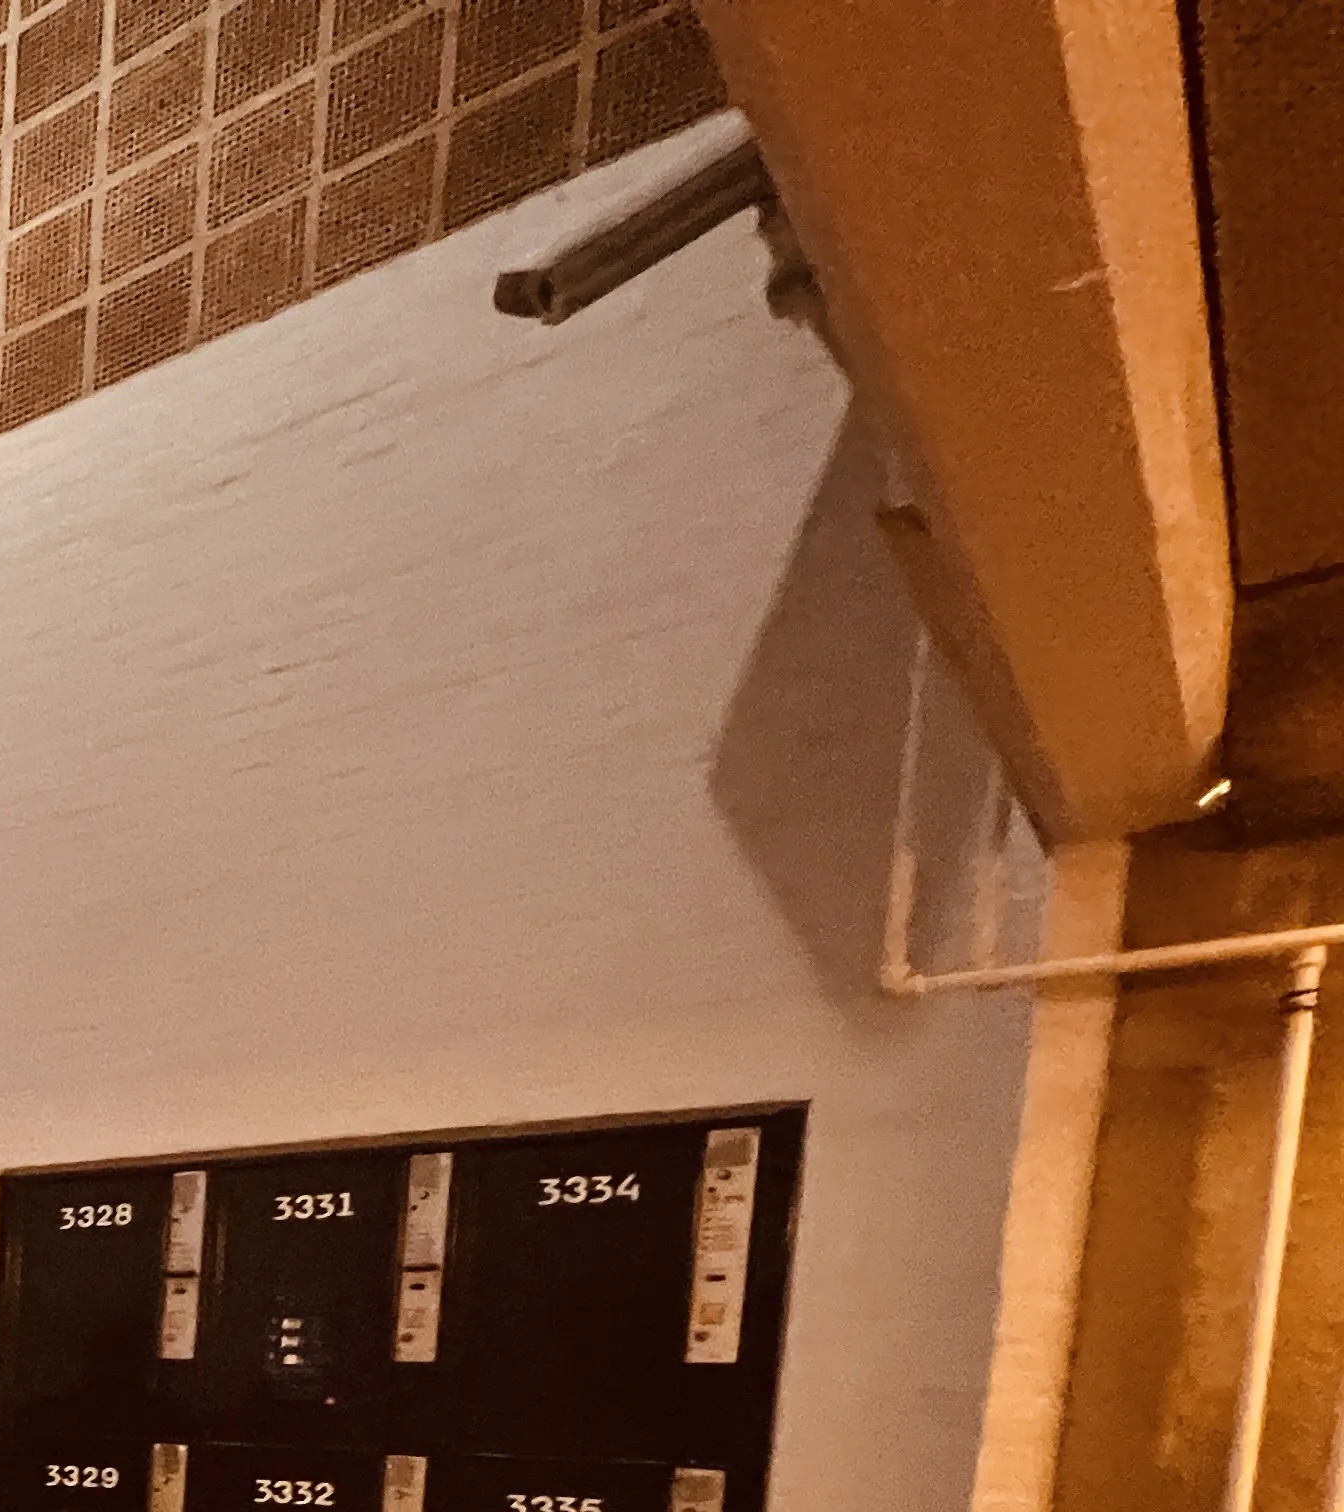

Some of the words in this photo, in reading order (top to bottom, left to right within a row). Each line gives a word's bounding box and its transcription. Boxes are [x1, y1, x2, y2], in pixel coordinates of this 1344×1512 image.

[538, 1173, 640, 1206] 3334
[59, 1202, 133, 1230] 3328
[273, 1192, 355, 1221] 3331
[45, 1464, 120, 1489] 3329
[253, 1479, 335, 1507] 3332
